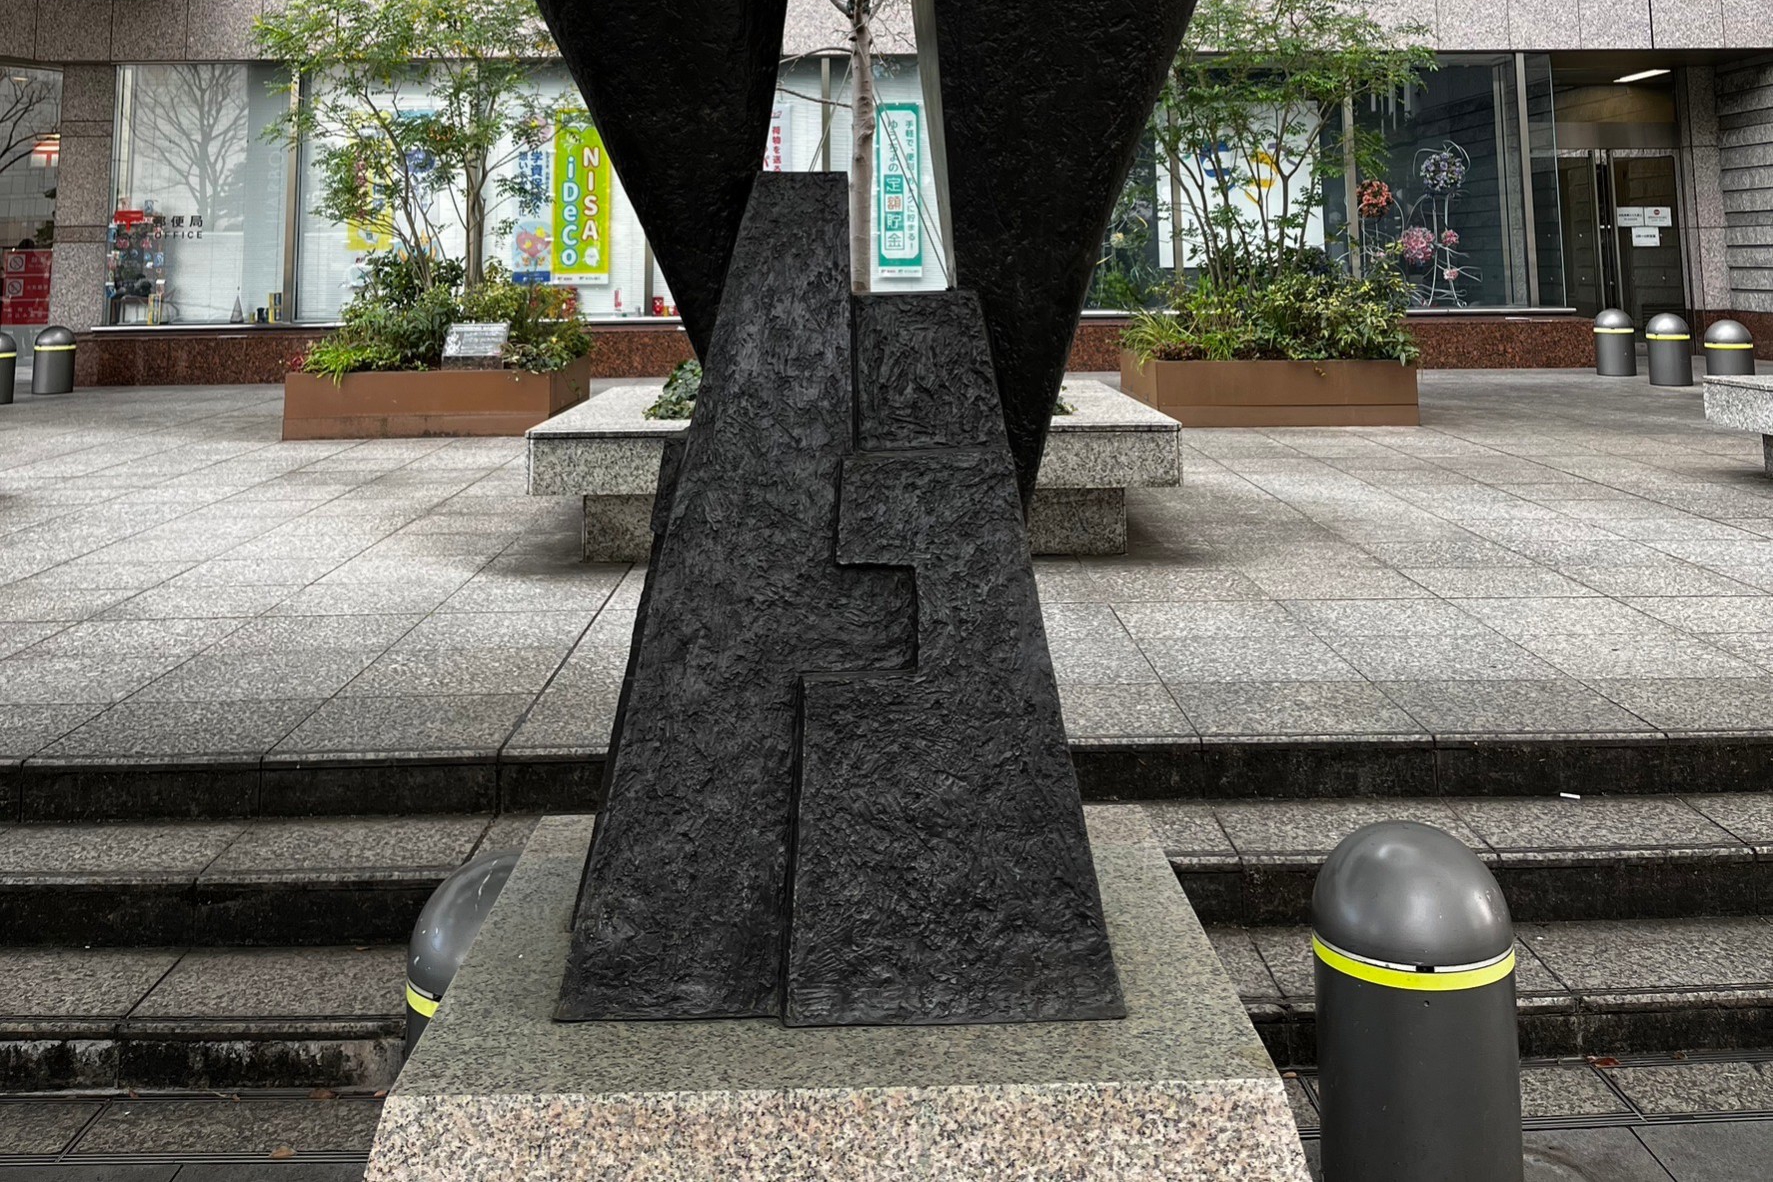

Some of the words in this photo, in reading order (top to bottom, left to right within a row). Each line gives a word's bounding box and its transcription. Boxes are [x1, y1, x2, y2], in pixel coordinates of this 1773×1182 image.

[154, 231, 203, 240] OFFICE
[561, 155, 581, 267] iDeCo
[582, 146, 600, 242] NISA
